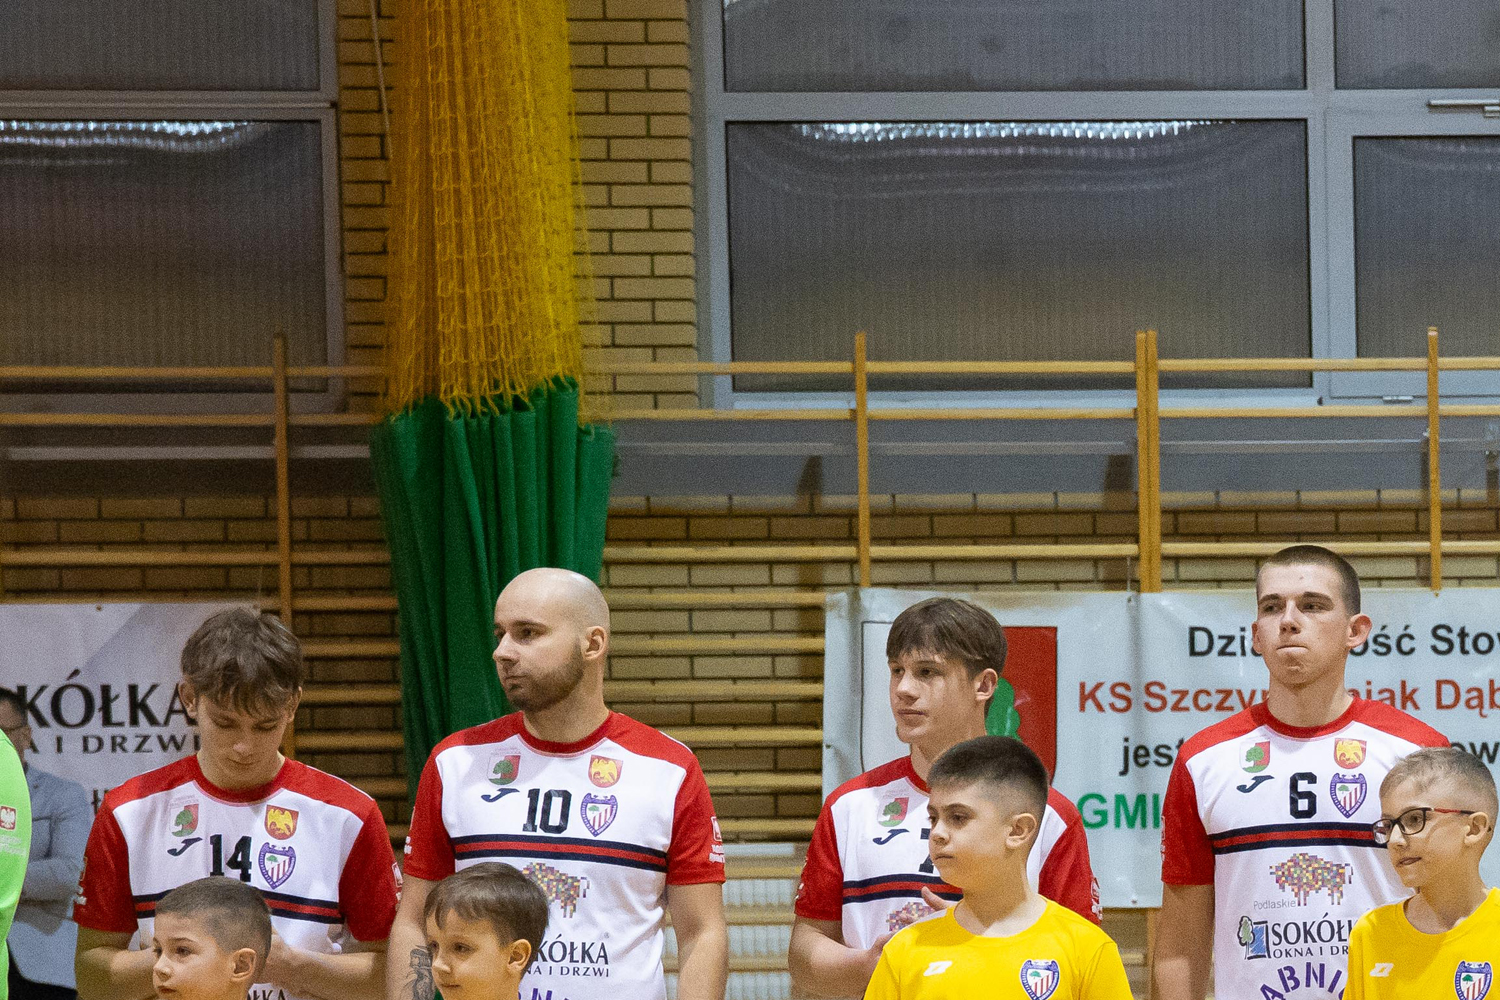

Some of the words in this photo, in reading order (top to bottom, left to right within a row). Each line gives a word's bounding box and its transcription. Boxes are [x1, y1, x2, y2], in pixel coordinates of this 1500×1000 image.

[17, 668, 198, 728] KÓŁKA
[1078, 681, 1132, 713] KS
[82, 734, 201, 754] DRZWI
[522, 788, 573, 834] 10
[1077, 793, 1160, 829] GMI
[1289, 772, 1318, 819] 6
[210, 834, 253, 882] 14
[1253, 899, 1297, 910] Podlaskie
[1271, 912, 1352, 946] SOKÓŁ
[536, 933, 609, 965] KÓŁKA
[1273, 946, 1314, 959] OKNA
[560, 966, 609, 977] DRZWI
